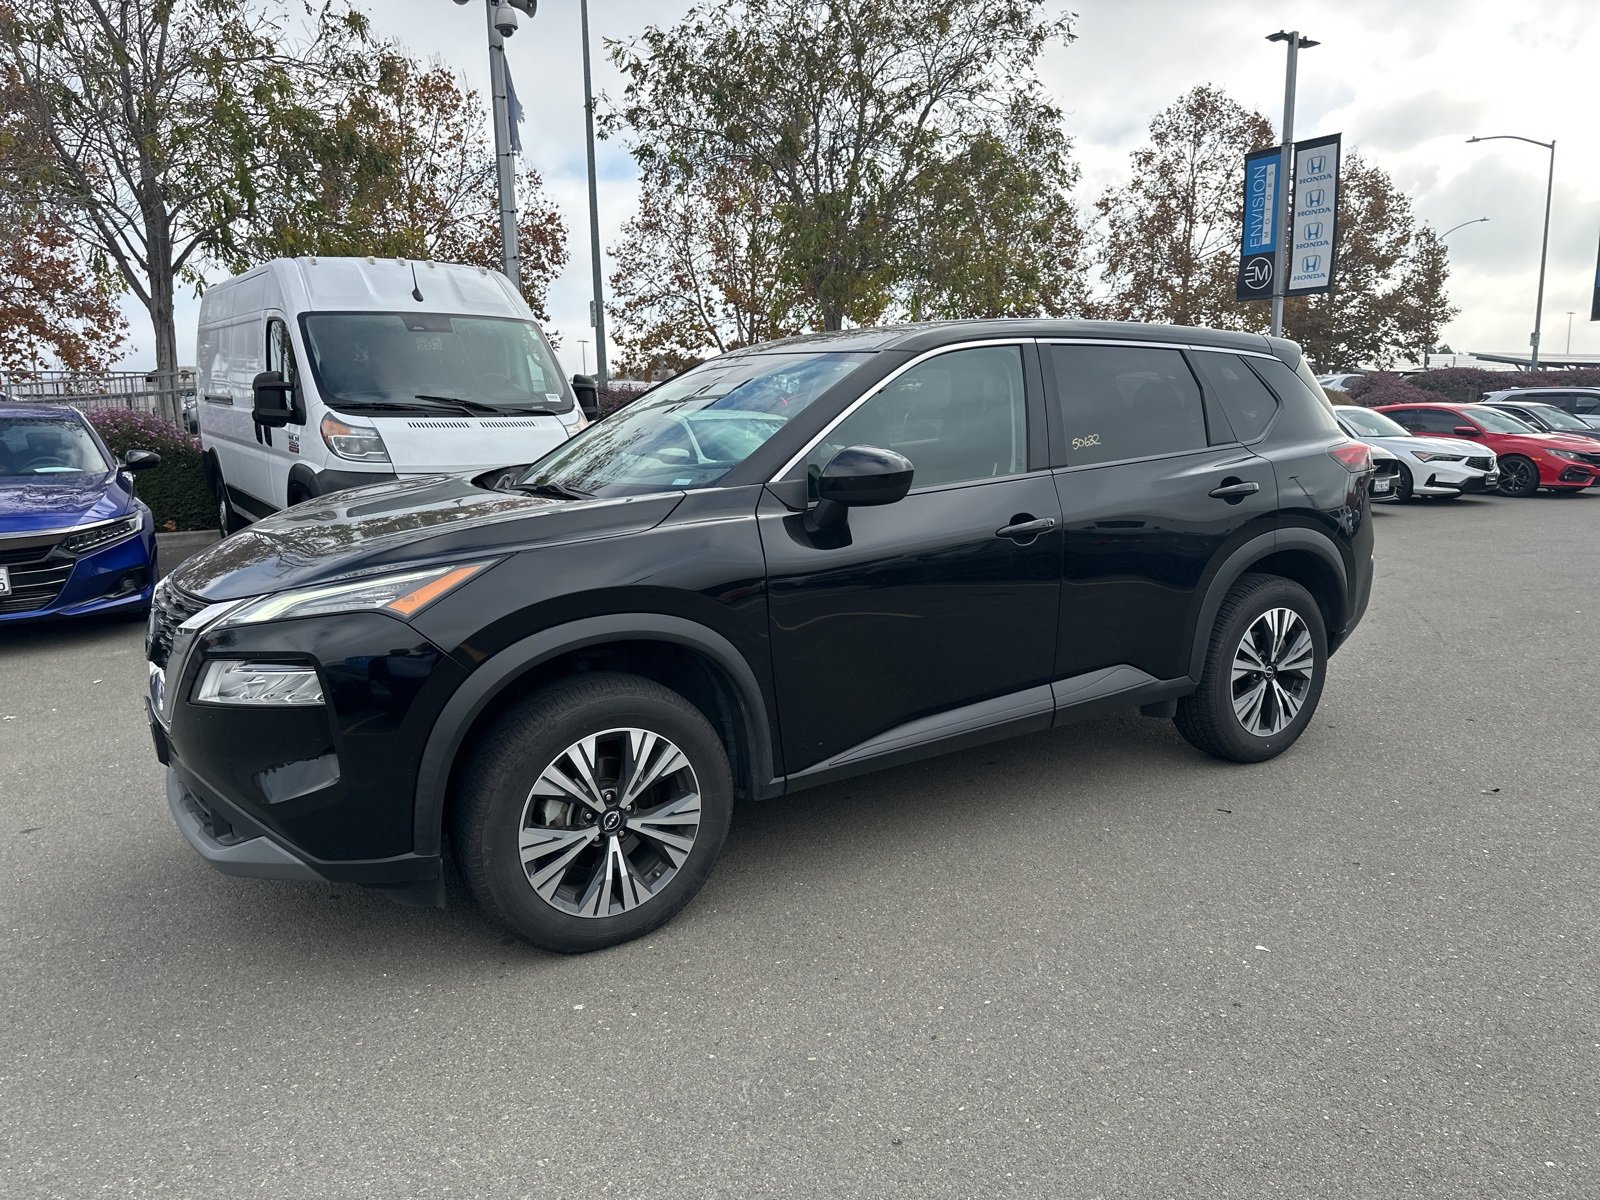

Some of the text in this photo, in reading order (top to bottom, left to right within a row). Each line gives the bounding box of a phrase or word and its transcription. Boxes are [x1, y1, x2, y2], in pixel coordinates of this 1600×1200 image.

[1298, 173, 1333, 184] HONDA
[1250, 166, 1266, 247] ENVISION
[1264, 171, 1273, 238] MOTORS
[1297, 207, 1331, 217] HONDA
[1296, 240, 1329, 249] HONDA
[1293, 273, 1326, 281] HONDA
[1072, 434, 1101, 450] 50632
